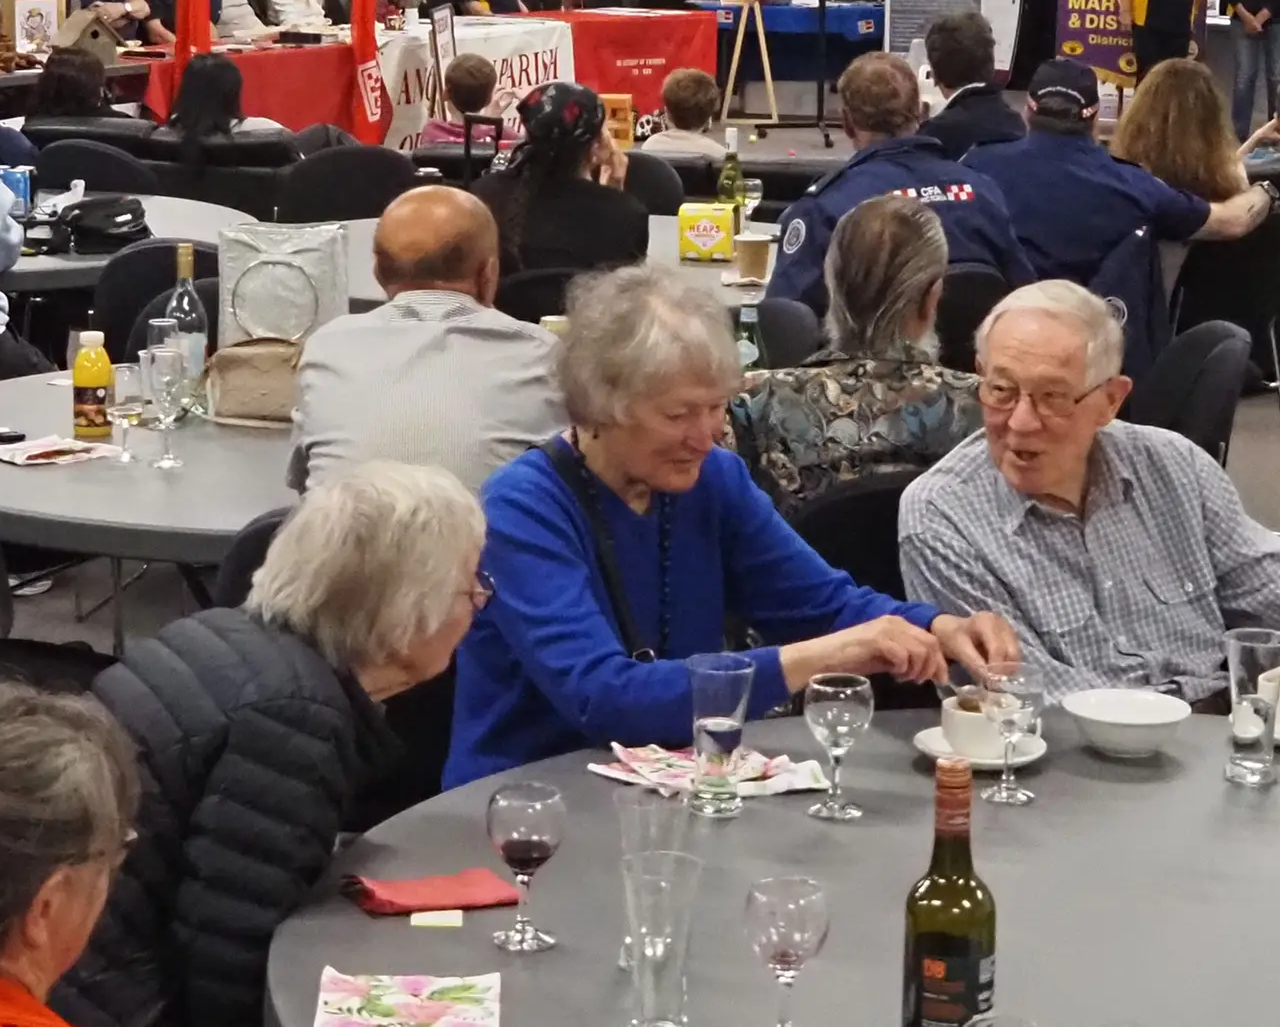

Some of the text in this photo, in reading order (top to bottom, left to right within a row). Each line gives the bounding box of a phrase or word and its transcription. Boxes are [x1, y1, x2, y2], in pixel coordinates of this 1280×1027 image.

[1068, 14, 1081, 28] &
[498, 47, 558, 88] PARISH
[920, 186, 942, 196] CFA
[689, 223, 721, 234] HEAPS
